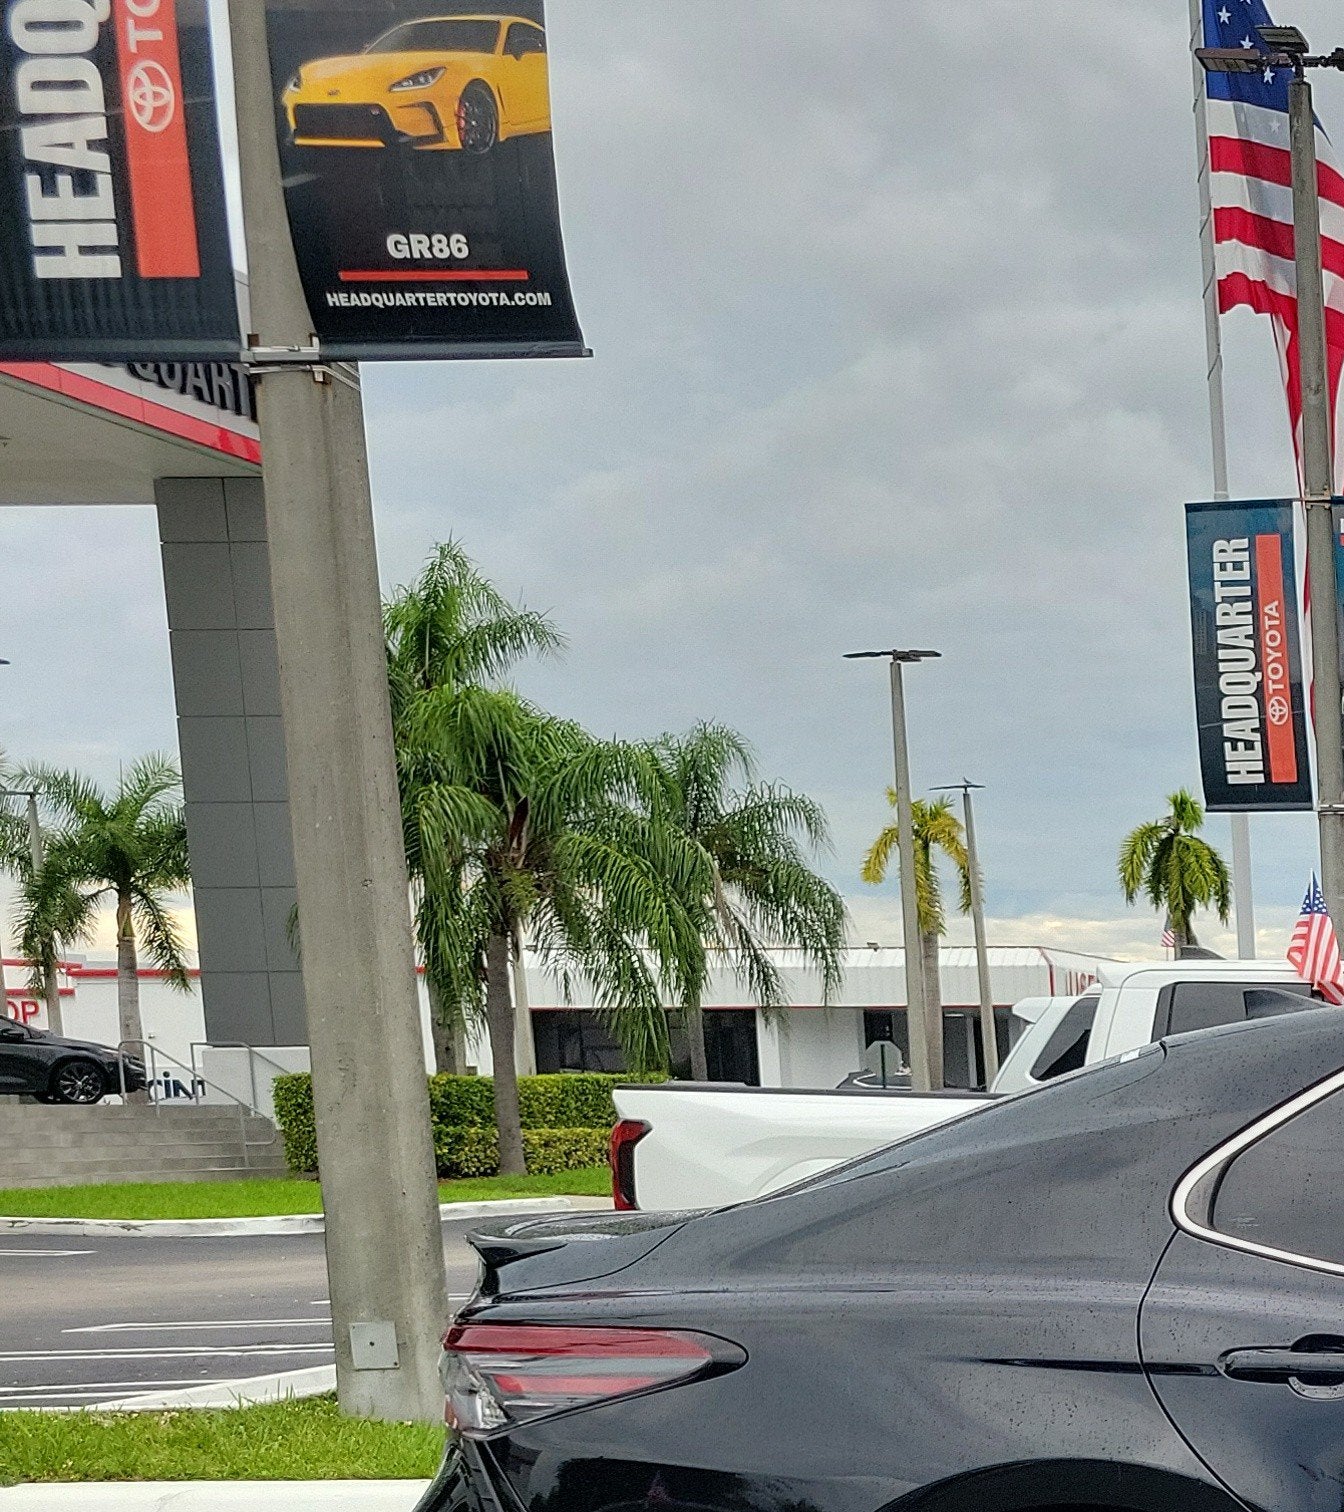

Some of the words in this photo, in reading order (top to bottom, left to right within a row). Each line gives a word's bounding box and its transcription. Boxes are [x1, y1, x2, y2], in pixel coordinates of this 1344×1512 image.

[386, 234, 469, 259] GR86
[326, 291, 552, 309] HEADQUARTERTOYOTA.COM
[1213, 537, 1265, 784] HEADQUARTER
[1265, 601, 1285, 694] TOYOTA
